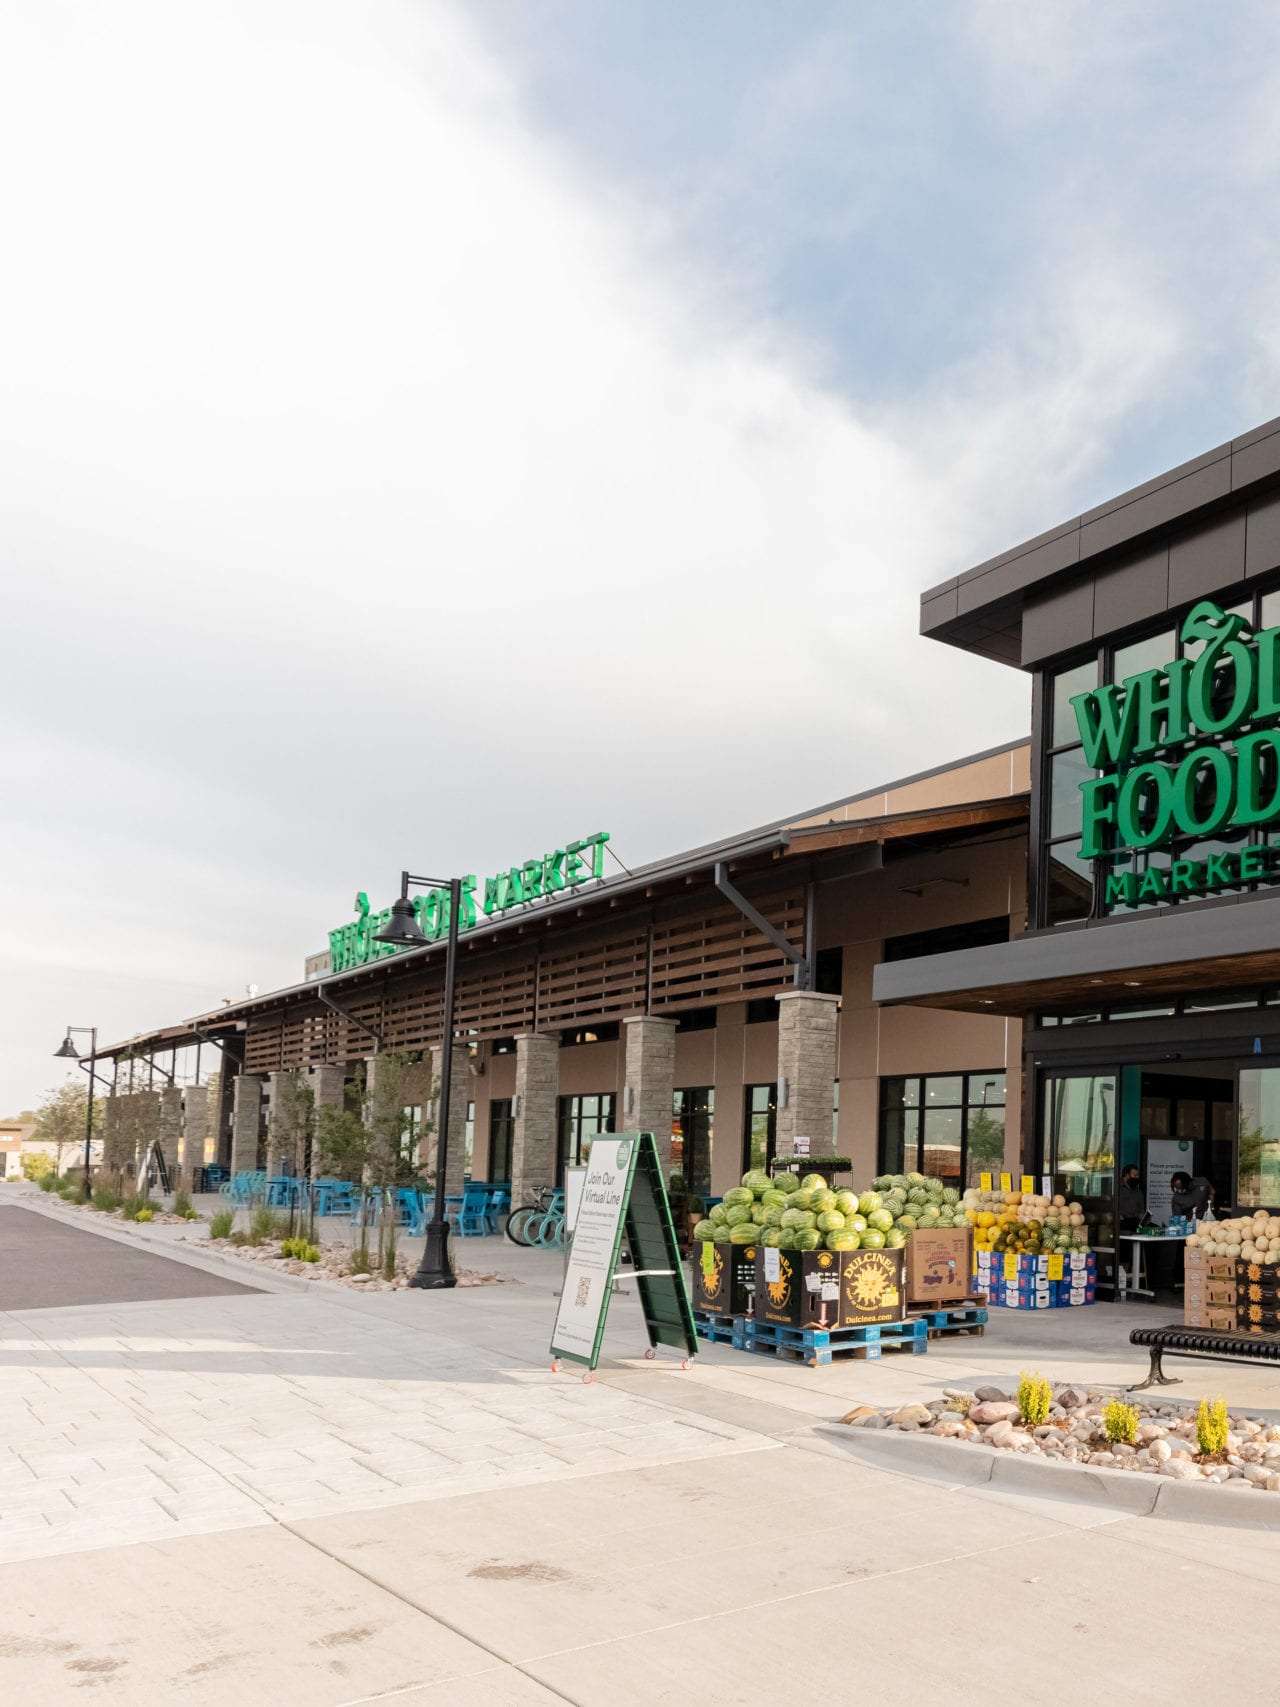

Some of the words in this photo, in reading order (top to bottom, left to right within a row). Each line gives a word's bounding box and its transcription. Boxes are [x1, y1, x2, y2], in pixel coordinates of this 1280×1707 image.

[484, 832, 609, 915] MARKET
[588, 1172, 601, 1185] Join
[603, 1172, 615, 1185] Our
[585, 1189, 605, 1203] Virtual
[606, 1191, 620, 1205] Line
[843, 1253, 897, 1279] DULCINEA
